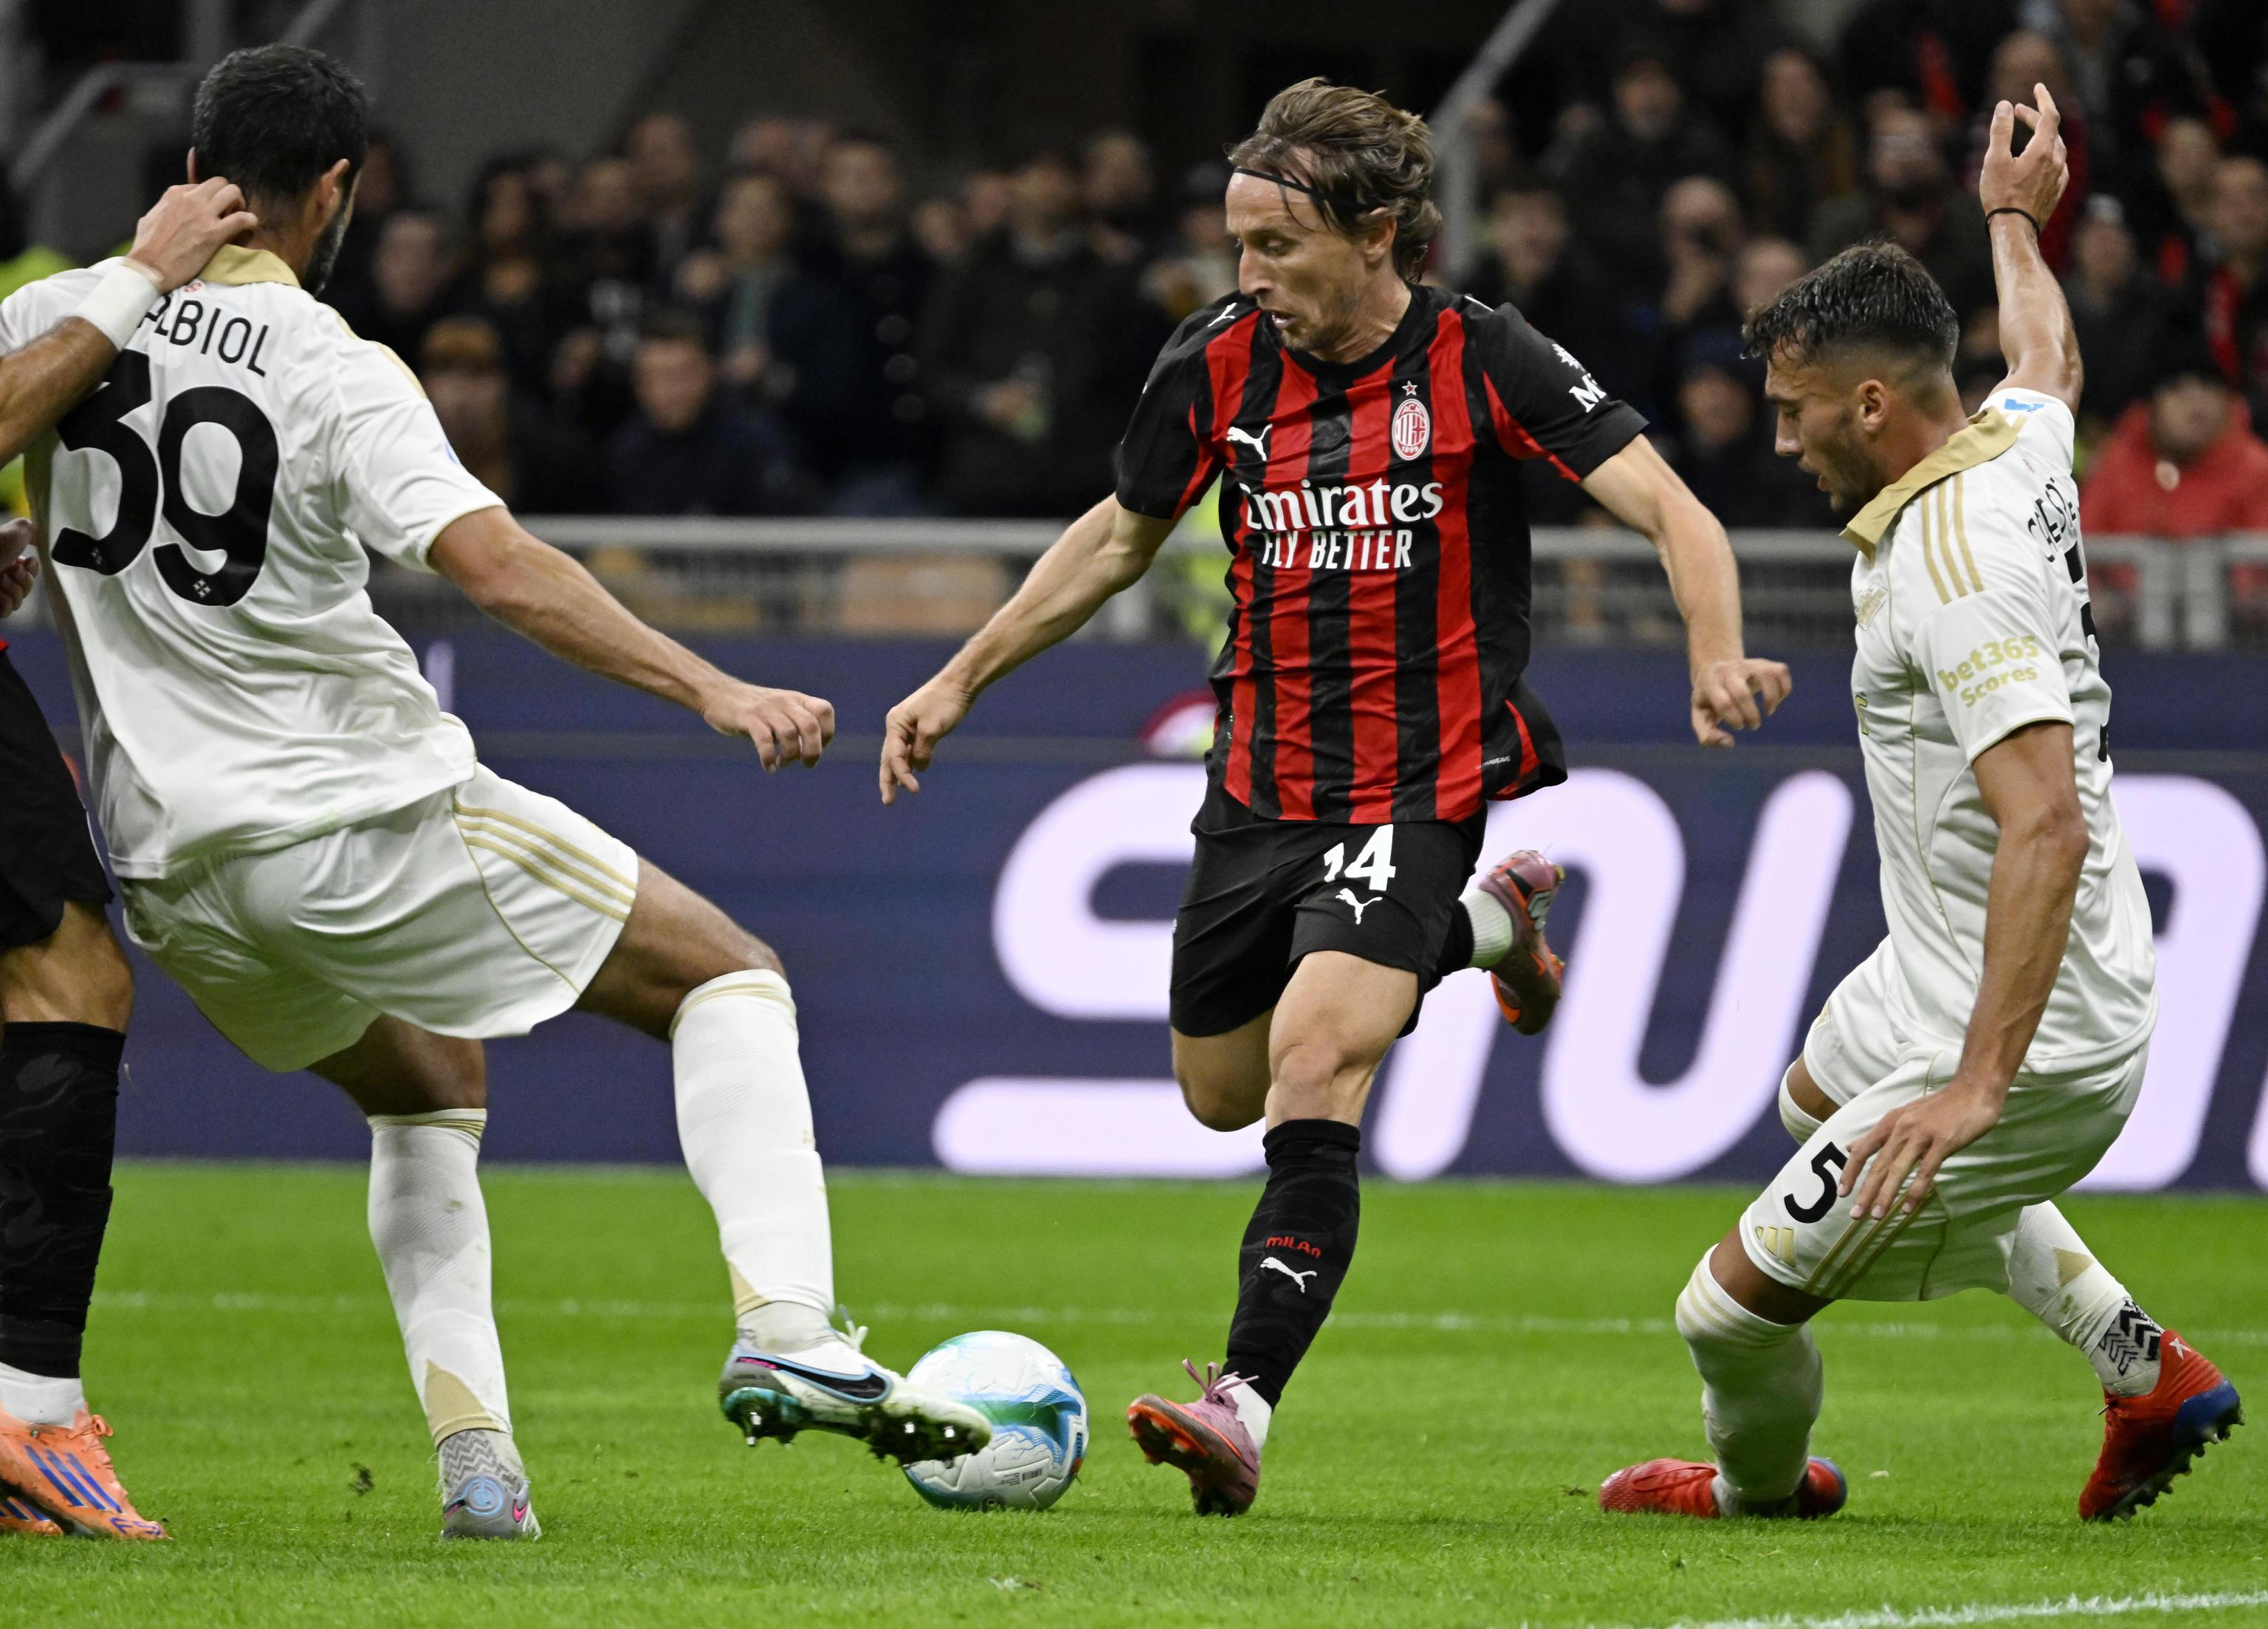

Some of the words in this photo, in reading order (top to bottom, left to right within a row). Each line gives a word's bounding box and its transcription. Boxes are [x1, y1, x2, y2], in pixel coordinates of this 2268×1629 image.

[52, 349, 279, 607] 39
[1401, 445, 1419, 453] 1899
[1261, 530, 1299, 569] FLY
[1307, 529, 1413, 570] BETTER
[1936, 635, 2041, 694] bet365
[1322, 823, 1397, 892] 14
[1784, 1141, 1849, 1224] 5
